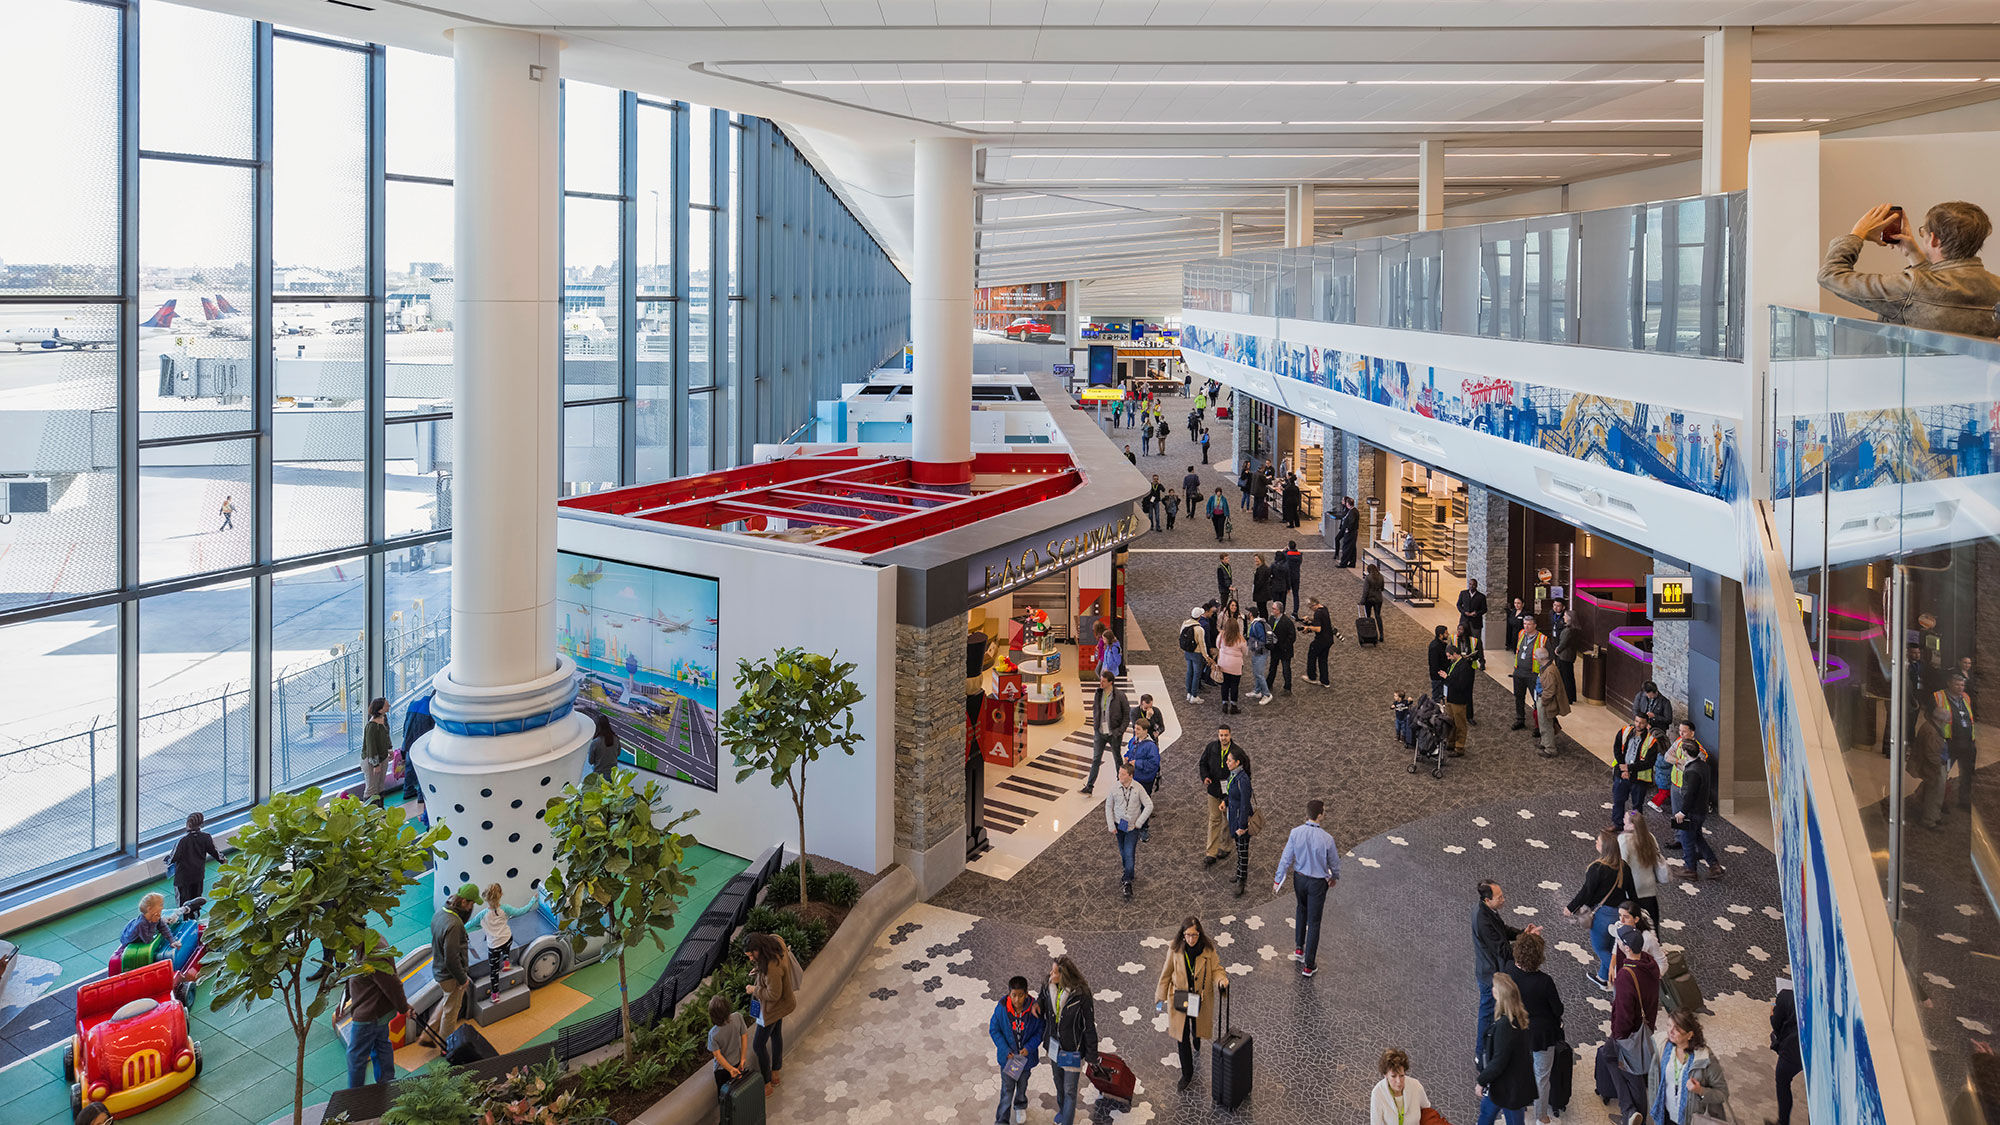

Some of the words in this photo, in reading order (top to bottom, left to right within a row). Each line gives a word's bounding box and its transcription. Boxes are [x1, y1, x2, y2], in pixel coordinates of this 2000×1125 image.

[1688, 423, 1701, 432] OF
[1656, 434, 1677, 443] NEW
[1683, 435, 1709, 445] YORK
[1001, 681, 1019, 695] A
[989, 741, 1009, 759] A
